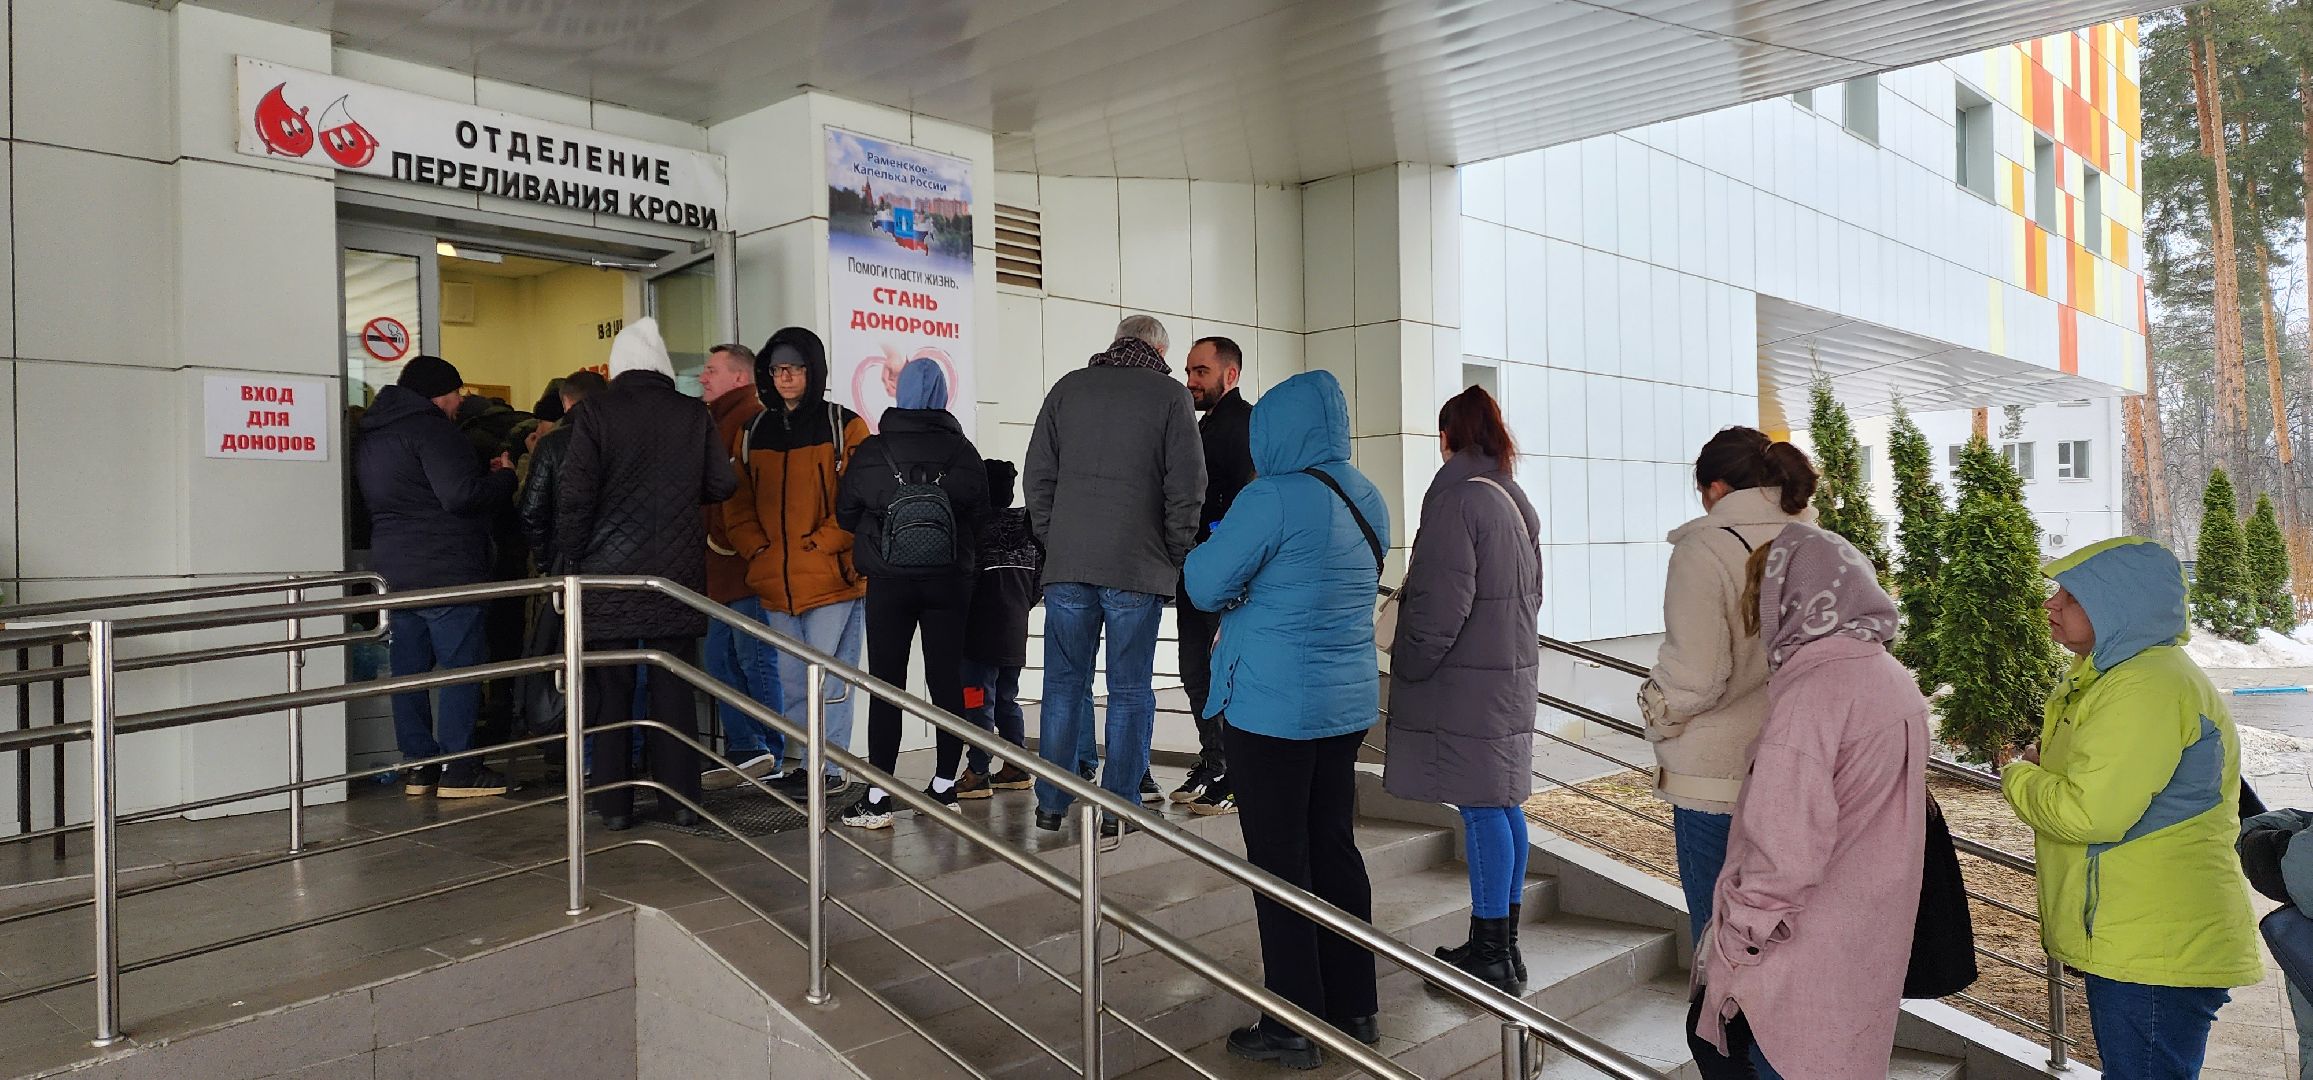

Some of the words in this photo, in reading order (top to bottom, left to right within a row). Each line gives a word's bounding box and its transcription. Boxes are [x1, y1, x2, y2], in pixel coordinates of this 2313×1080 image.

[455, 120, 670, 186] ОТДЕЛЕНИЕ
[867, 152, 928, 174] Раменское
[391, 150, 619, 214] ПЕРЕЛИВАНИЯ
[628, 192, 718, 231] КРОВИ
[853, 162, 907, 183] Капелька
[910, 175, 947, 192] России
[848, 256, 888, 278] Помоги
[889, 267, 922, 284] спасти
[873, 286, 938, 312] СТАНЬ
[850, 309, 959, 339] ДОНОРОМ!
